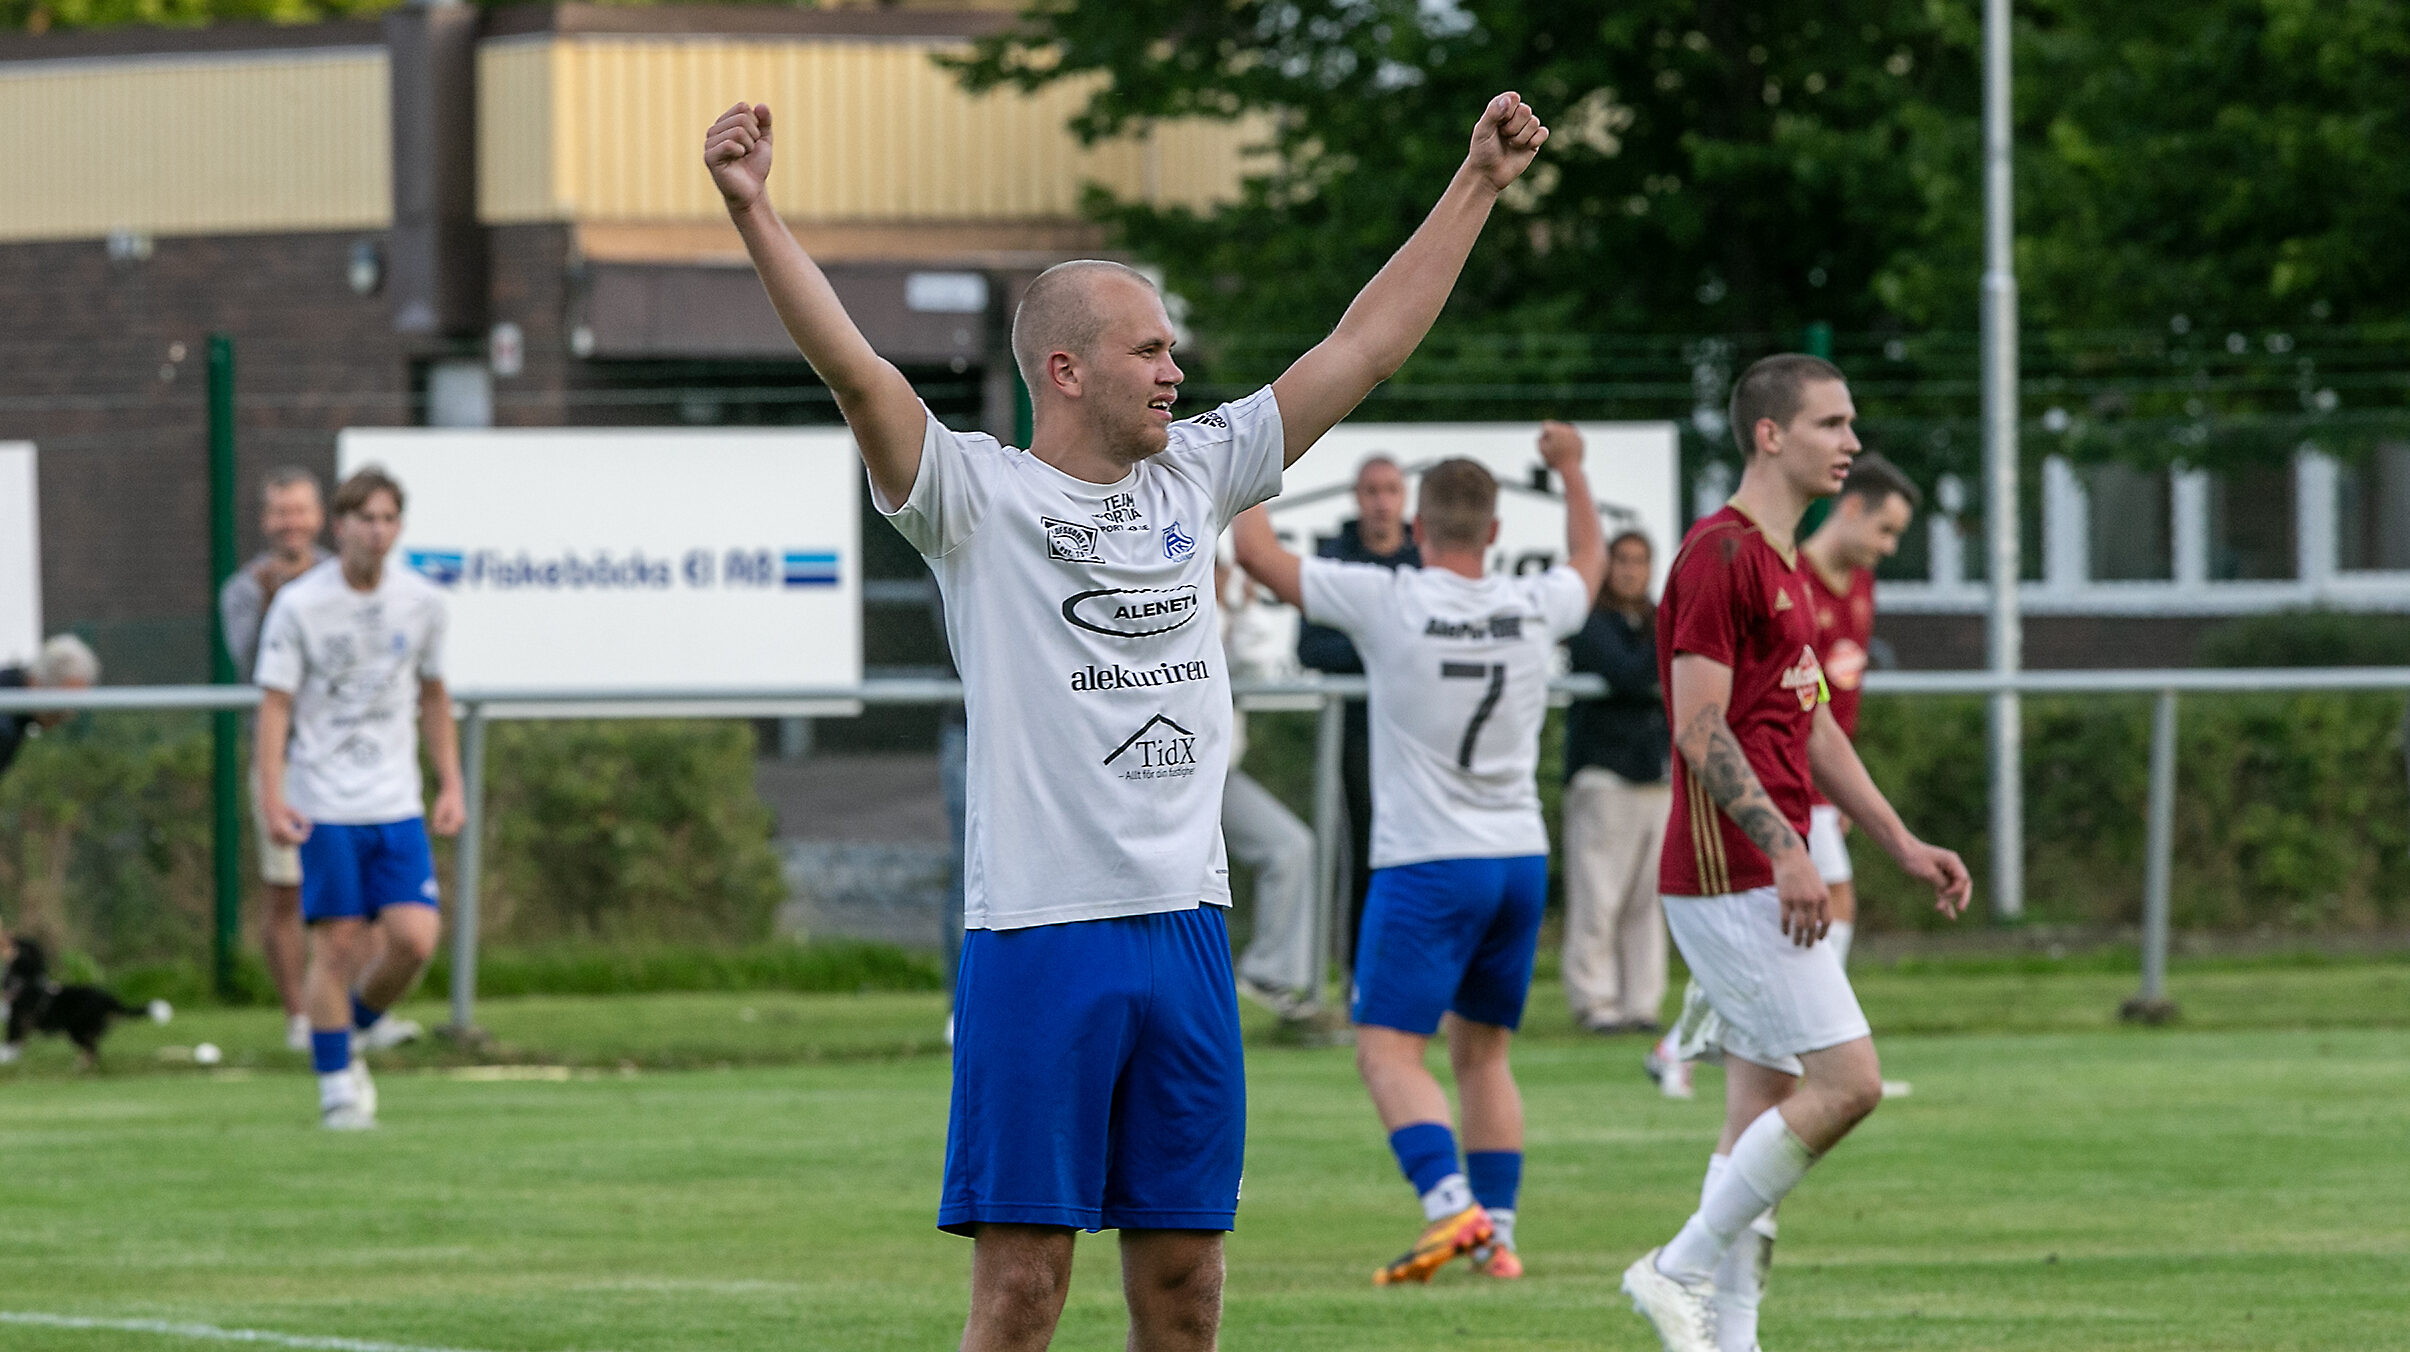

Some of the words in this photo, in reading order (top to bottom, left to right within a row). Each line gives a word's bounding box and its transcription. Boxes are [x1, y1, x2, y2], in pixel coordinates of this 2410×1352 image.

[1071, 660, 1210, 691] alekuriren
[1441, 661, 1505, 770] 7
[1135, 737, 1196, 768] TidX
